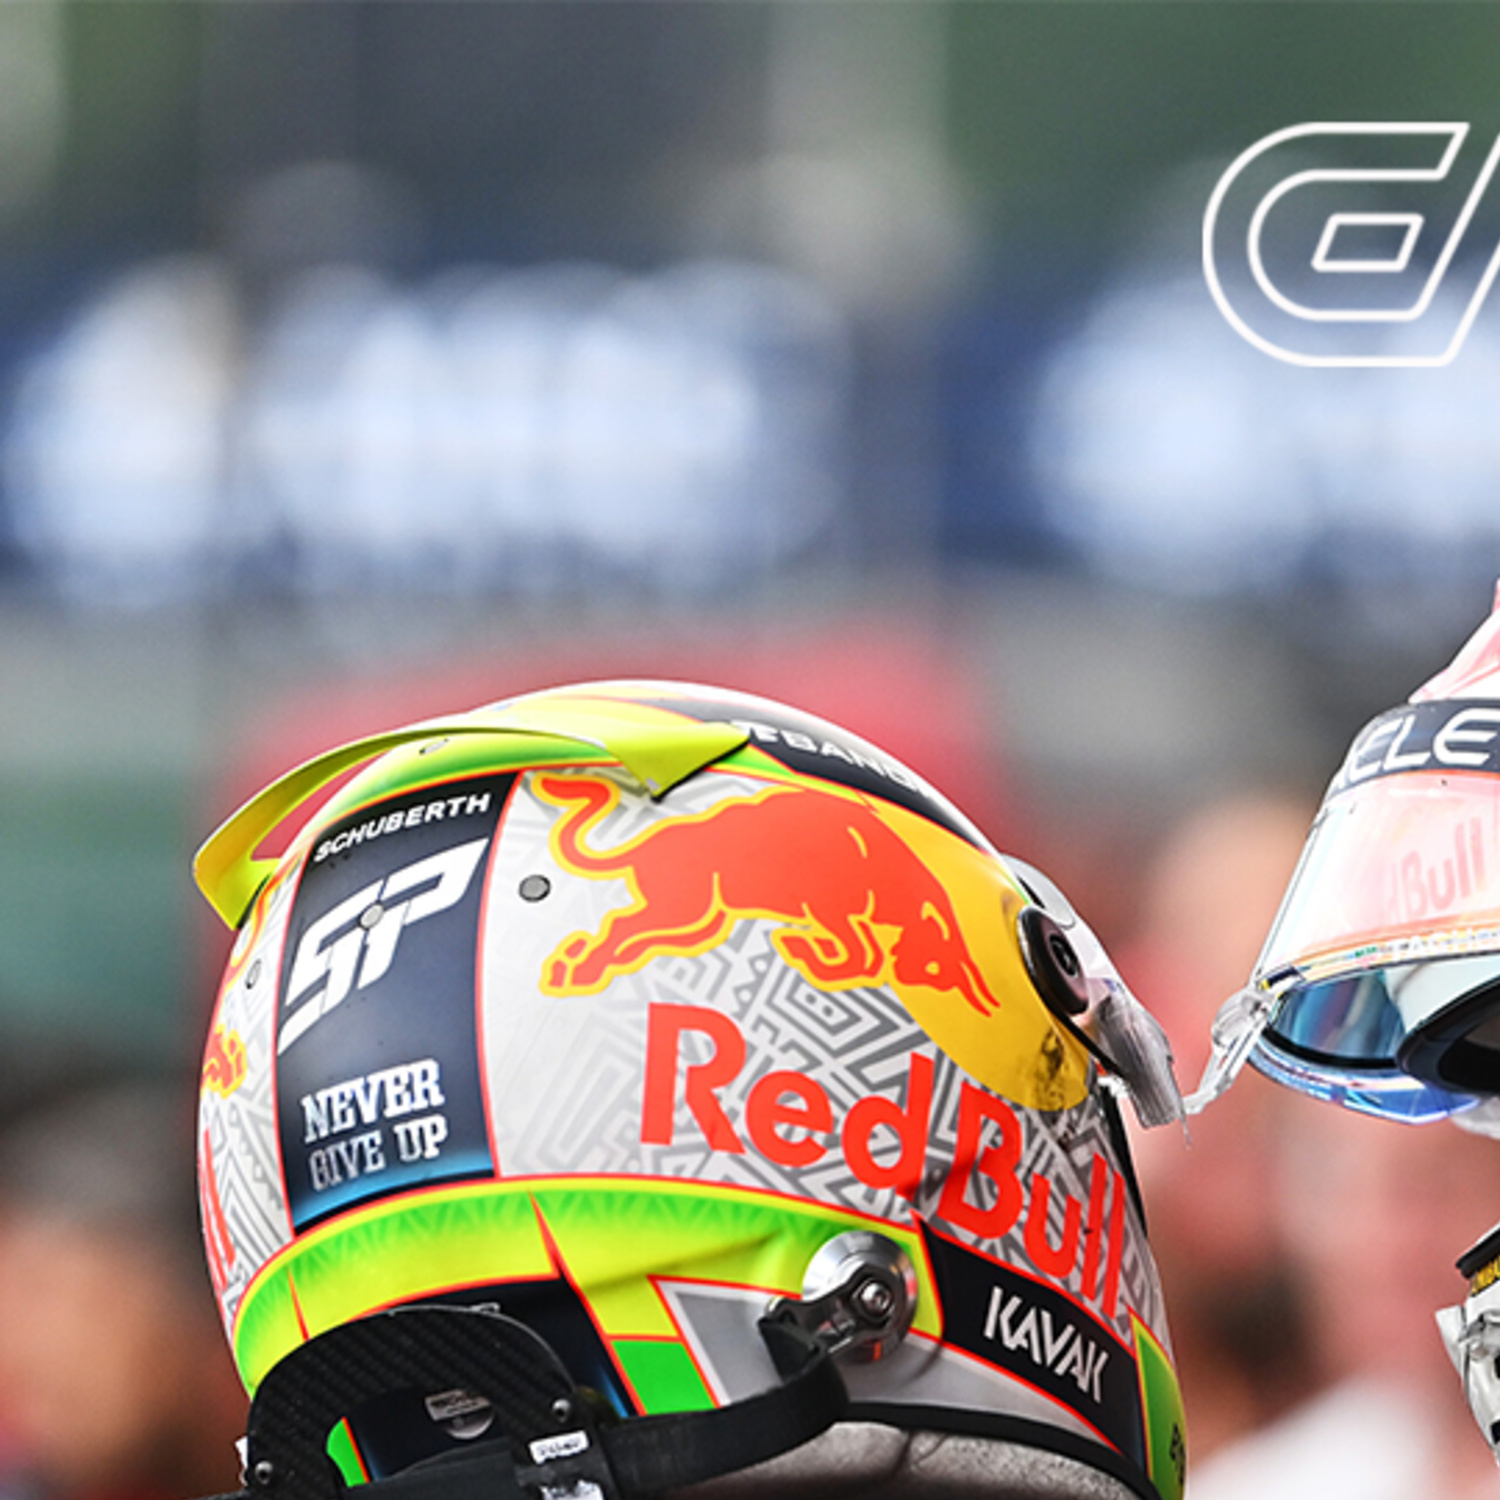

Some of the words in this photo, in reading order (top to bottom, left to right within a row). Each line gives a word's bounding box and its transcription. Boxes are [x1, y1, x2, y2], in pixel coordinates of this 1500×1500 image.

[314, 793, 490, 862] SCHUBERTH
[301, 1058, 445, 1143] NEVER
[308, 1133, 385, 1191] GIVE
[394, 1114, 448, 1162] UP
[640, 1002, 934, 1201] Red
[938, 1082, 1126, 1319] Bull
[984, 1286, 1108, 1402] KAVAK
